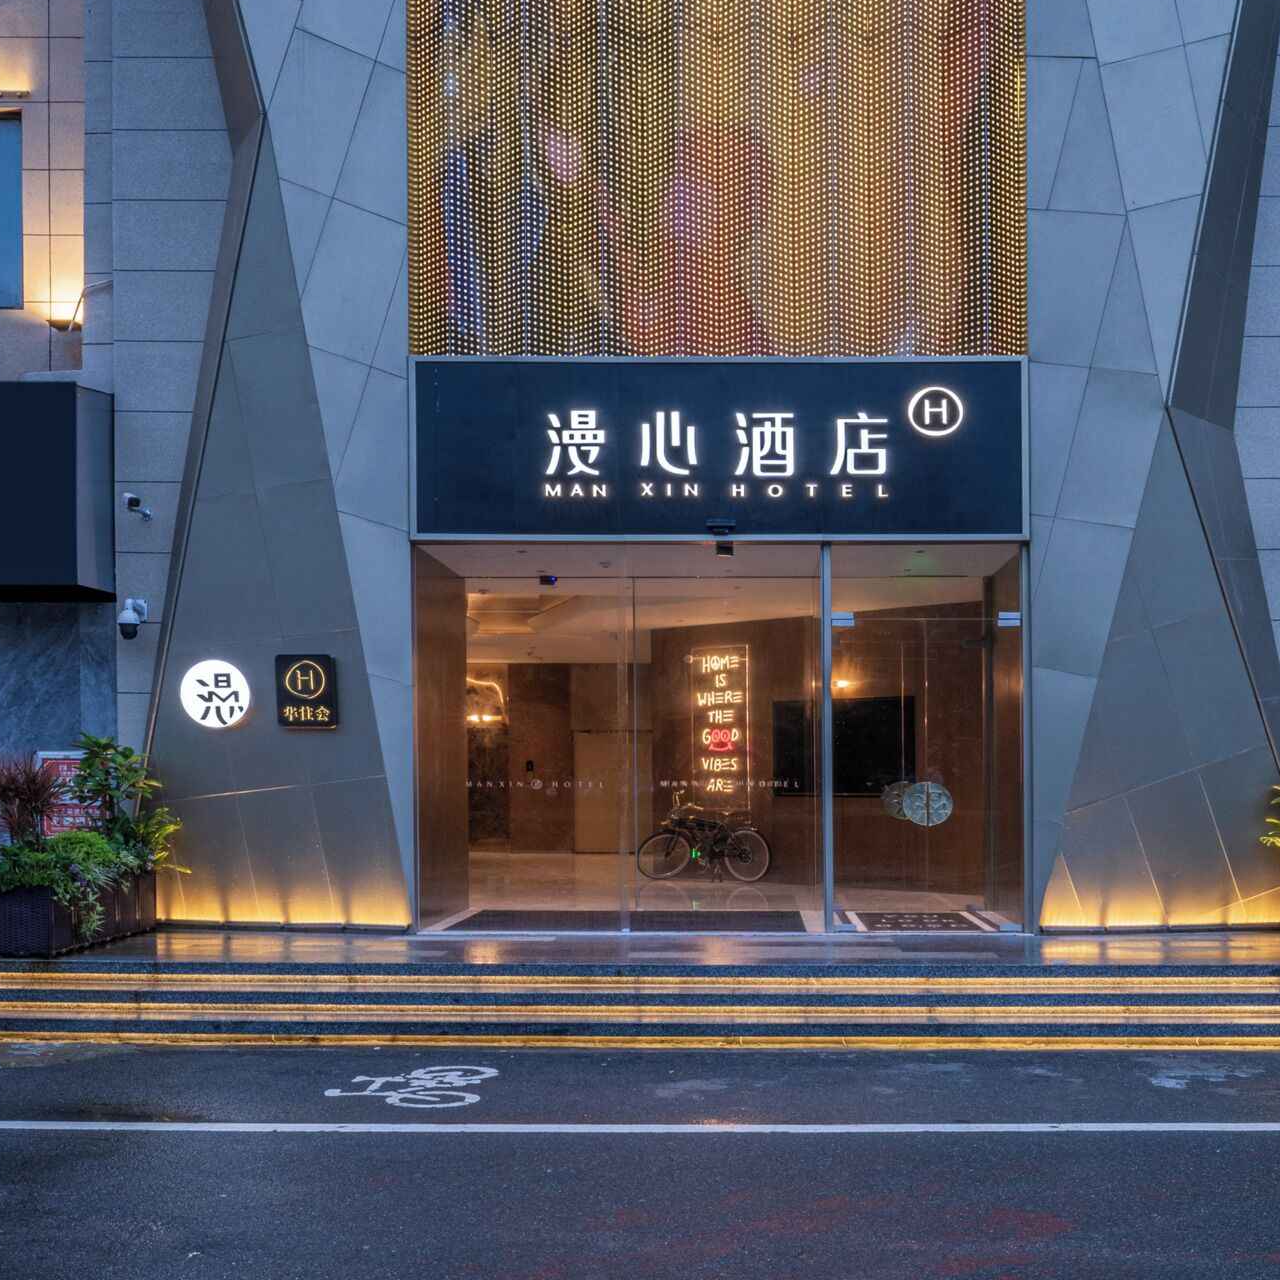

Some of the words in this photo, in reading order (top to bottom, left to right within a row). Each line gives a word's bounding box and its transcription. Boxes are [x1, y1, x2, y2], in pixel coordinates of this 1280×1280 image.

[544, 409, 889, 478] 漫心酒店
[544, 483, 608, 498] MAN
[641, 482, 700, 497] XIN
[732, 483, 889, 498] HOTEL
[715, 674, 727, 688] IS
[697, 691, 744, 707] WHERE
[283, 704, 331, 723] 华住会
[707, 710, 734, 724] THE
[702, 728, 740, 745] GOOD
[701, 757, 738, 772] VIBES
[706, 778, 734, 793] ARE
